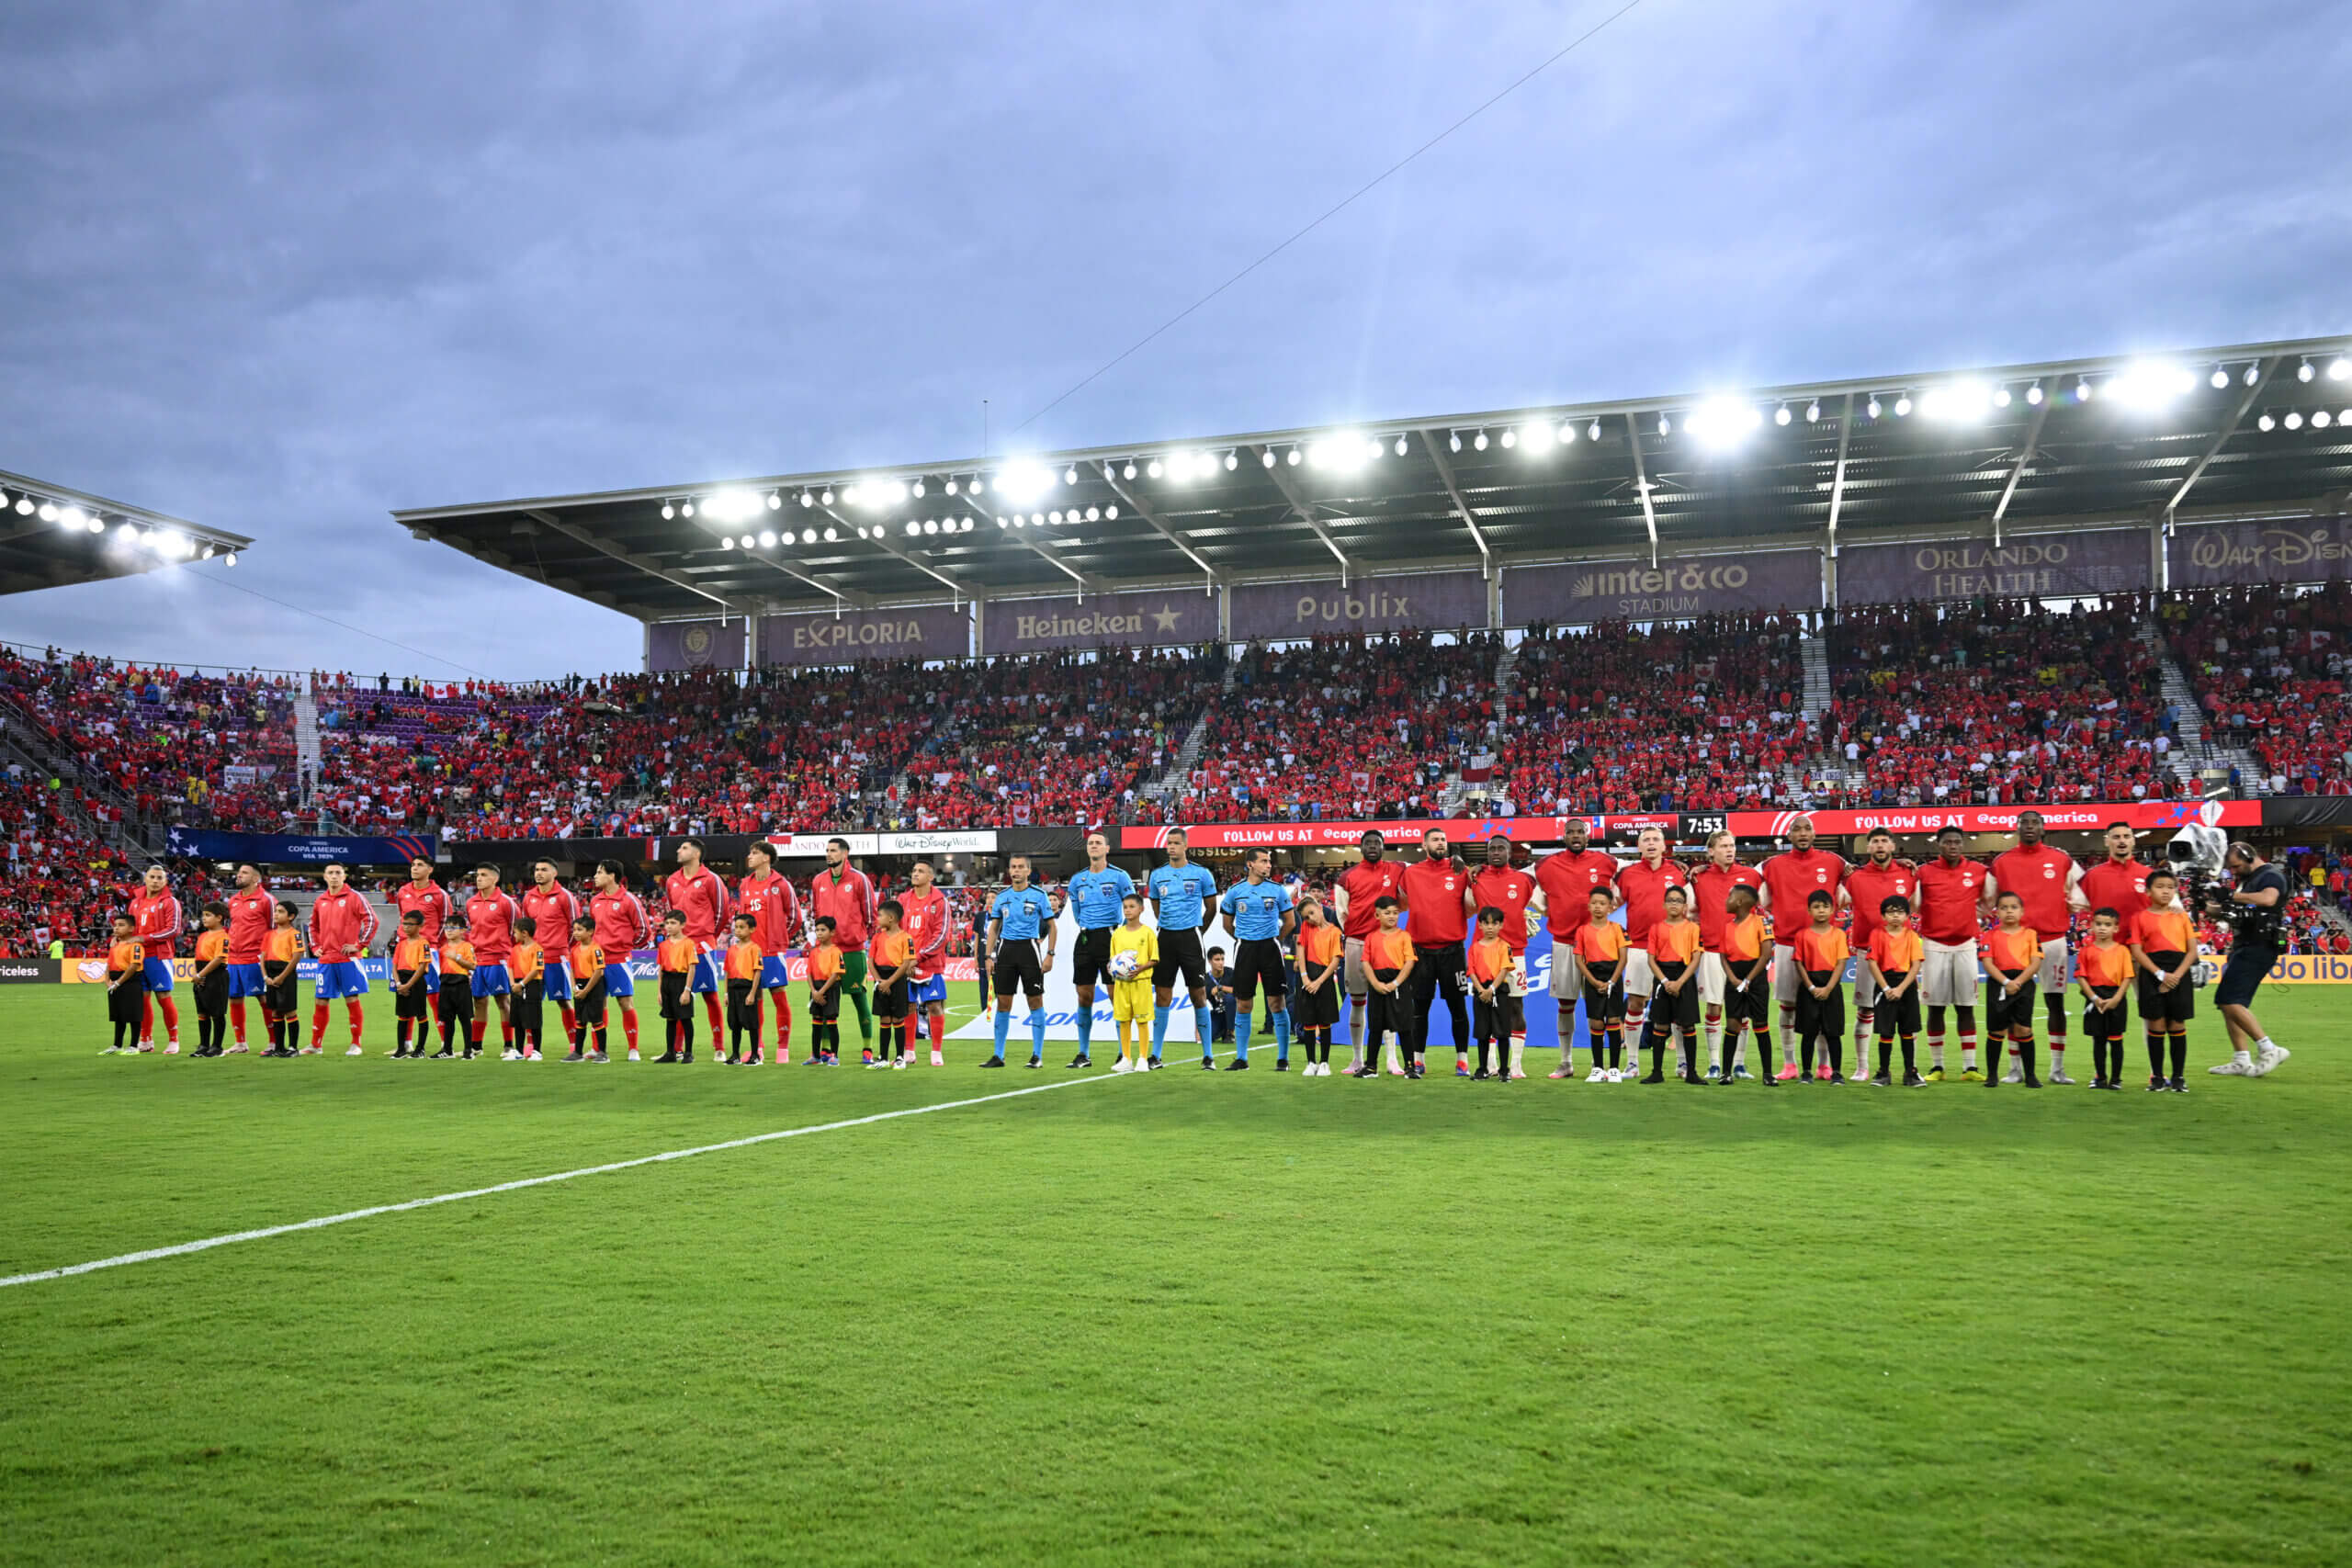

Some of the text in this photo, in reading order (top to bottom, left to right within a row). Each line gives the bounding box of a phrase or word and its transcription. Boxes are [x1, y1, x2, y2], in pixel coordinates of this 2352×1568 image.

[1916, 544, 2068, 571] ORLANDO
[1933, 569, 2053, 597] HEALTH
[1296, 591, 1410, 623] Publix
[1618, 596, 1699, 615] STADIUM
[1016, 611, 1144, 639] Heineken
[793, 618, 923, 649] EXPLORIA
[812, 647, 905, 660] RESORTS
[1612, 820, 1669, 830] COPA AMERICA
[1688, 817, 1724, 834] 7:53
[1855, 815, 1917, 829] FOLLOW
[1921, 815, 1941, 828] US
[1946, 814, 1965, 828] AT
[1223, 830, 1274, 842] FOLLOW
[1278, 829, 1295, 841] US
[1297, 829, 1314, 841] AT
[750, 898, 762, 912] 16
[910, 915, 922, 929] 10
[296, 963, 318, 971] ATAM
[2052, 964, 2065, 981] 15
[1455, 971, 1467, 987] 16
